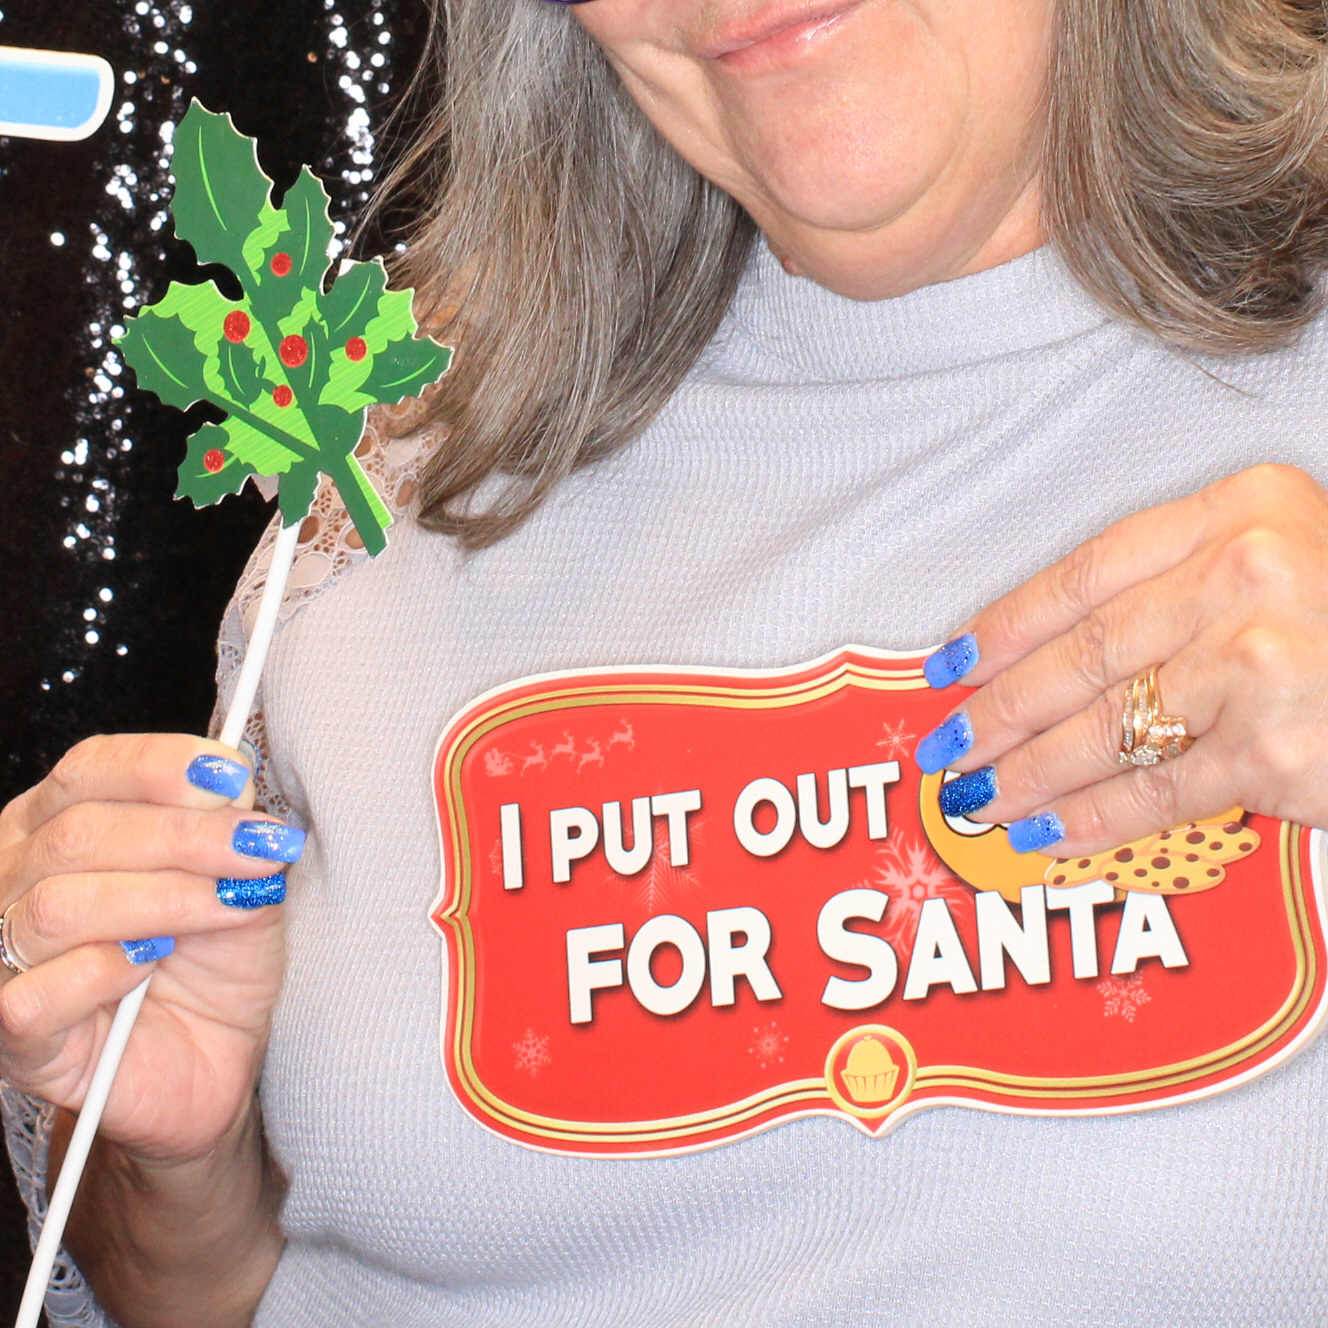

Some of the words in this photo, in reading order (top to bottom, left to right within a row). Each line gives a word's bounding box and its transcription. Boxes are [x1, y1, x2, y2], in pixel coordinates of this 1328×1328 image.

[500, 803, 524, 890] I
[549, 790, 702, 884] PUT
[733, 760, 901, 858] OUT
[566, 906, 783, 1024] FOR
[816, 878, 1190, 1012] SANTA
